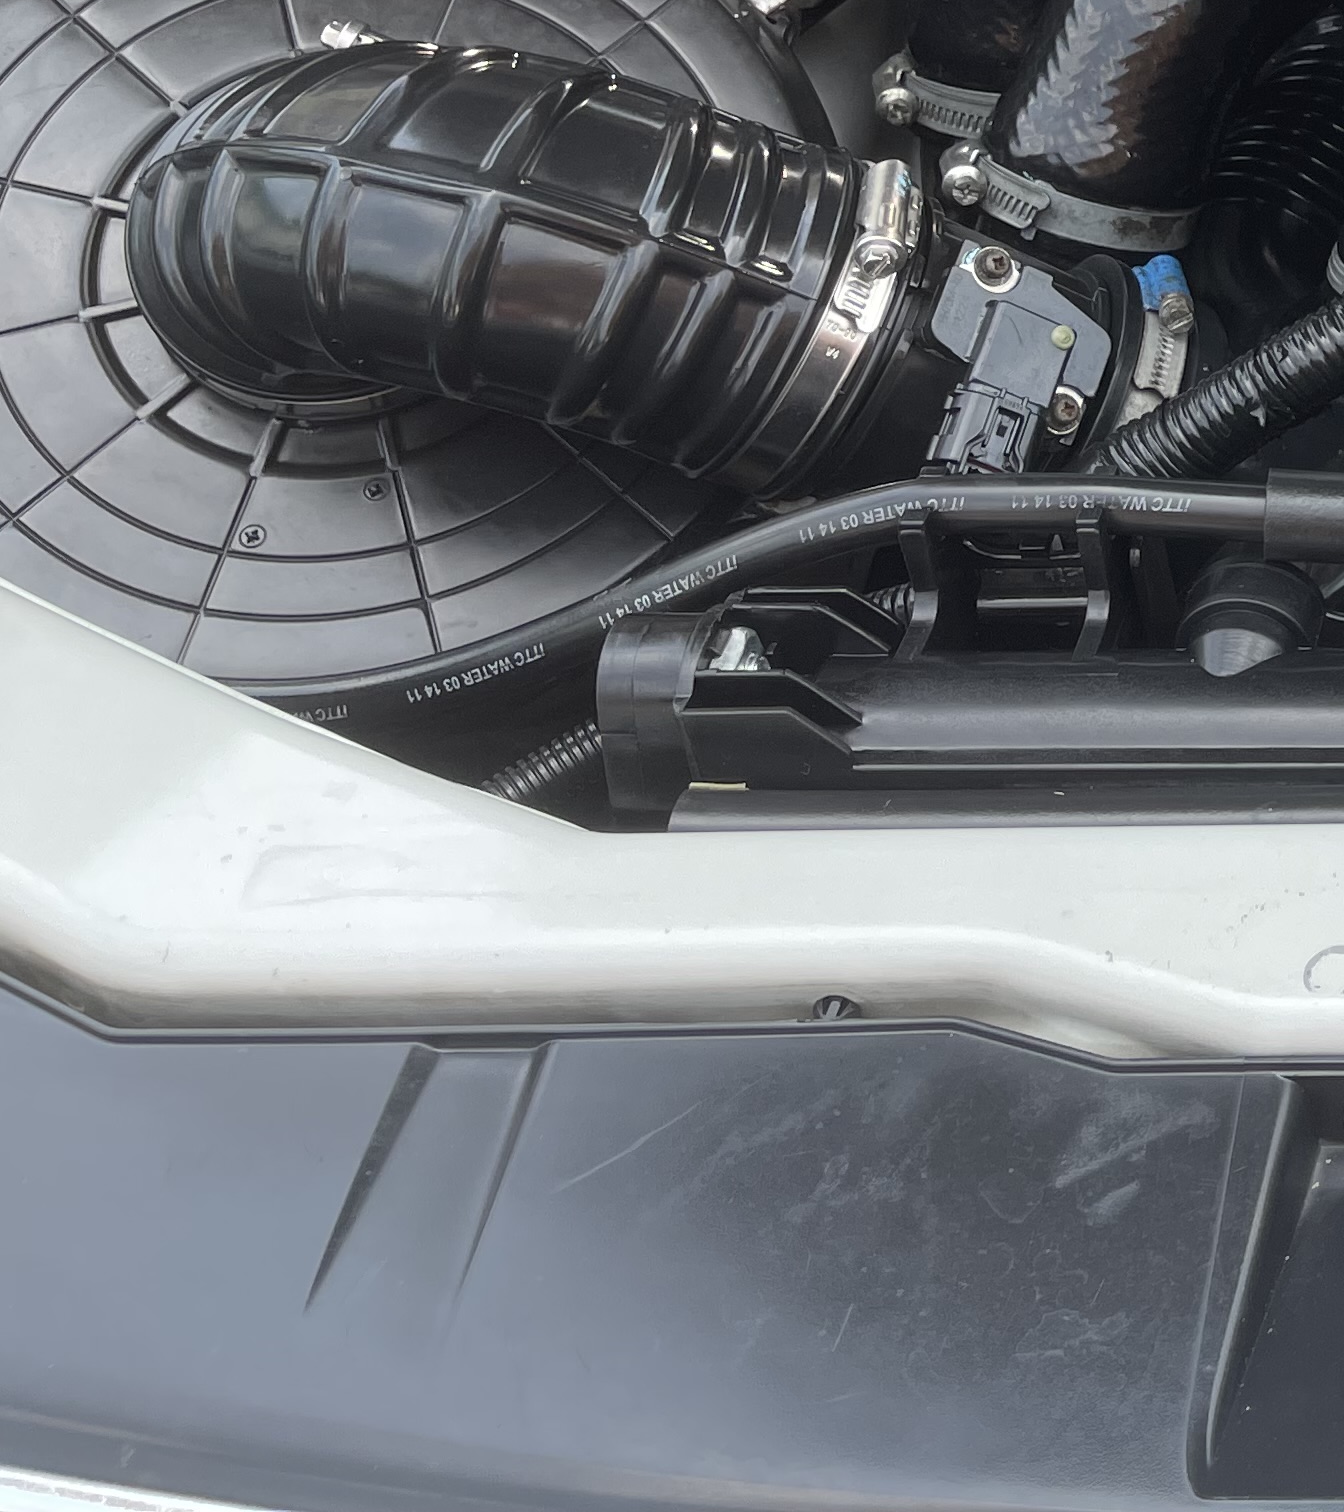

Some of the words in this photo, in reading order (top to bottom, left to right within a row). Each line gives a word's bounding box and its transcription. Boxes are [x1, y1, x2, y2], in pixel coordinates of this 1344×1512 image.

[1011, 494, 1027, 510] 11
[1034, 494, 1051, 510] 14
[1058, 494, 1078, 510] 03
[819, 520, 837, 537] 14
[840, 514, 859, 531] 03
[799, 527, 816, 544] 11
[634, 594, 651, 613] 03
[598, 614, 615, 630] 11
[461, 655, 515, 686] WATER
[424, 682, 442, 699] 14
[443, 675, 461, 694] 03
[405, 689, 423, 704] 11
